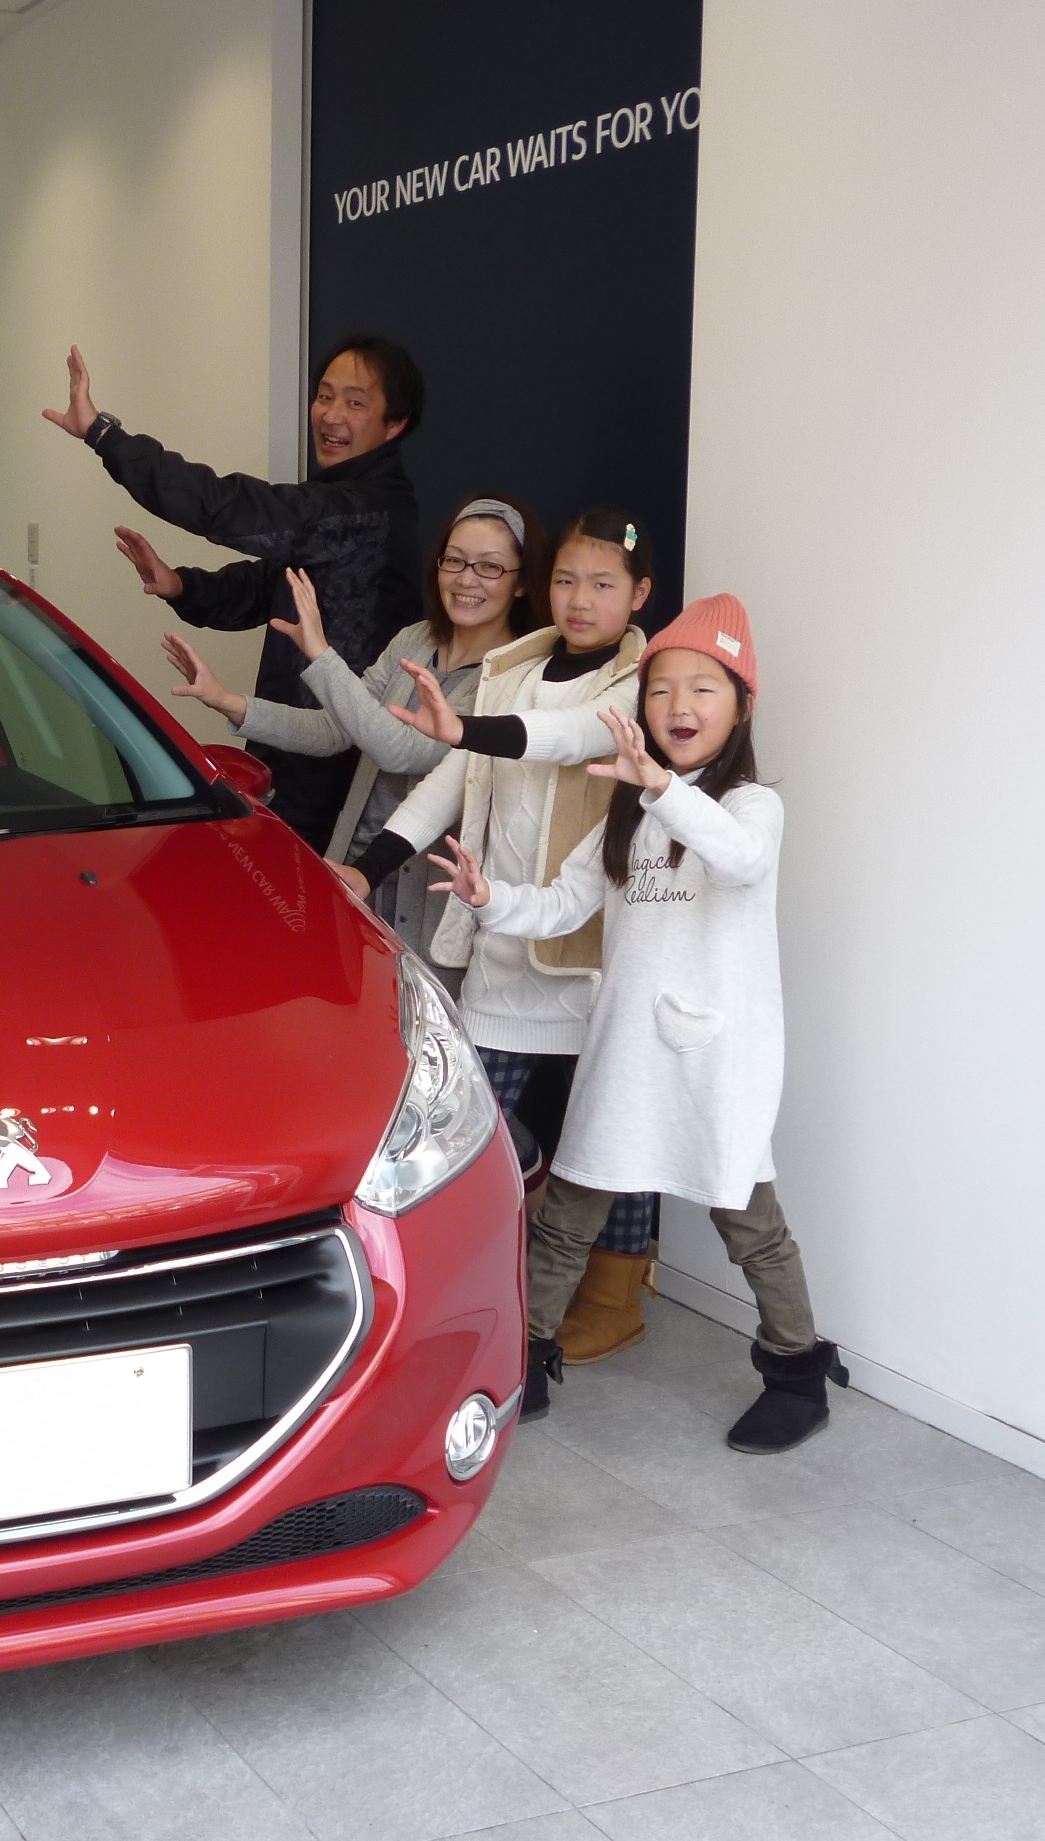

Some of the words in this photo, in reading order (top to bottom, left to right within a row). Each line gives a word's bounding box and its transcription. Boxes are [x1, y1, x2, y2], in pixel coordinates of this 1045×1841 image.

[334, 179, 389, 223] YOUR
[395, 161, 449, 208] NEW
[453, 147, 502, 192] CAR
[506, 120, 587, 177] WAITS
[596, 102, 653, 153] FOR
[660, 87, 701, 135] YO
[624, 875, 696, 906] Realism
